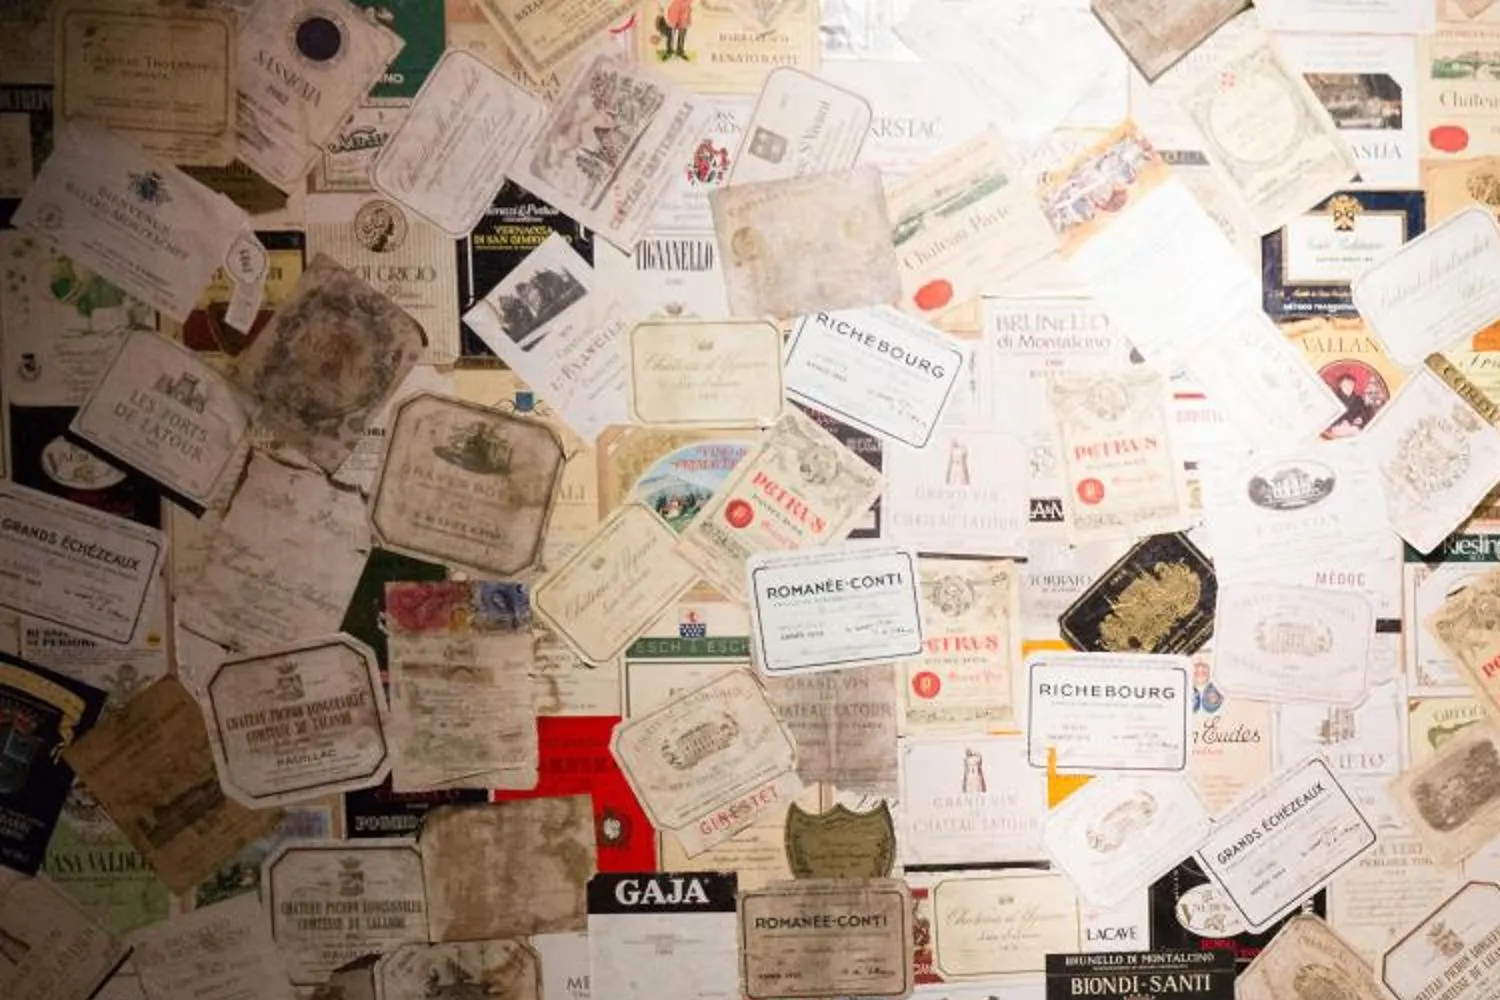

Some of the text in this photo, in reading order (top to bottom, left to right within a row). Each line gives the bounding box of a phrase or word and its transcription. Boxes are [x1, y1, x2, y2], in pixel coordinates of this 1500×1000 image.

[815, 311, 946, 381] RICHEBOURG
[1038, 681, 1177, 701] RICHEBOURG
[778, 704, 828, 718] HATEAU
[615, 878, 709, 905] GAJA
[1086, 924, 1138, 941] LACAVE
[1071, 974, 1212, 996] BIONDI-SANTI
